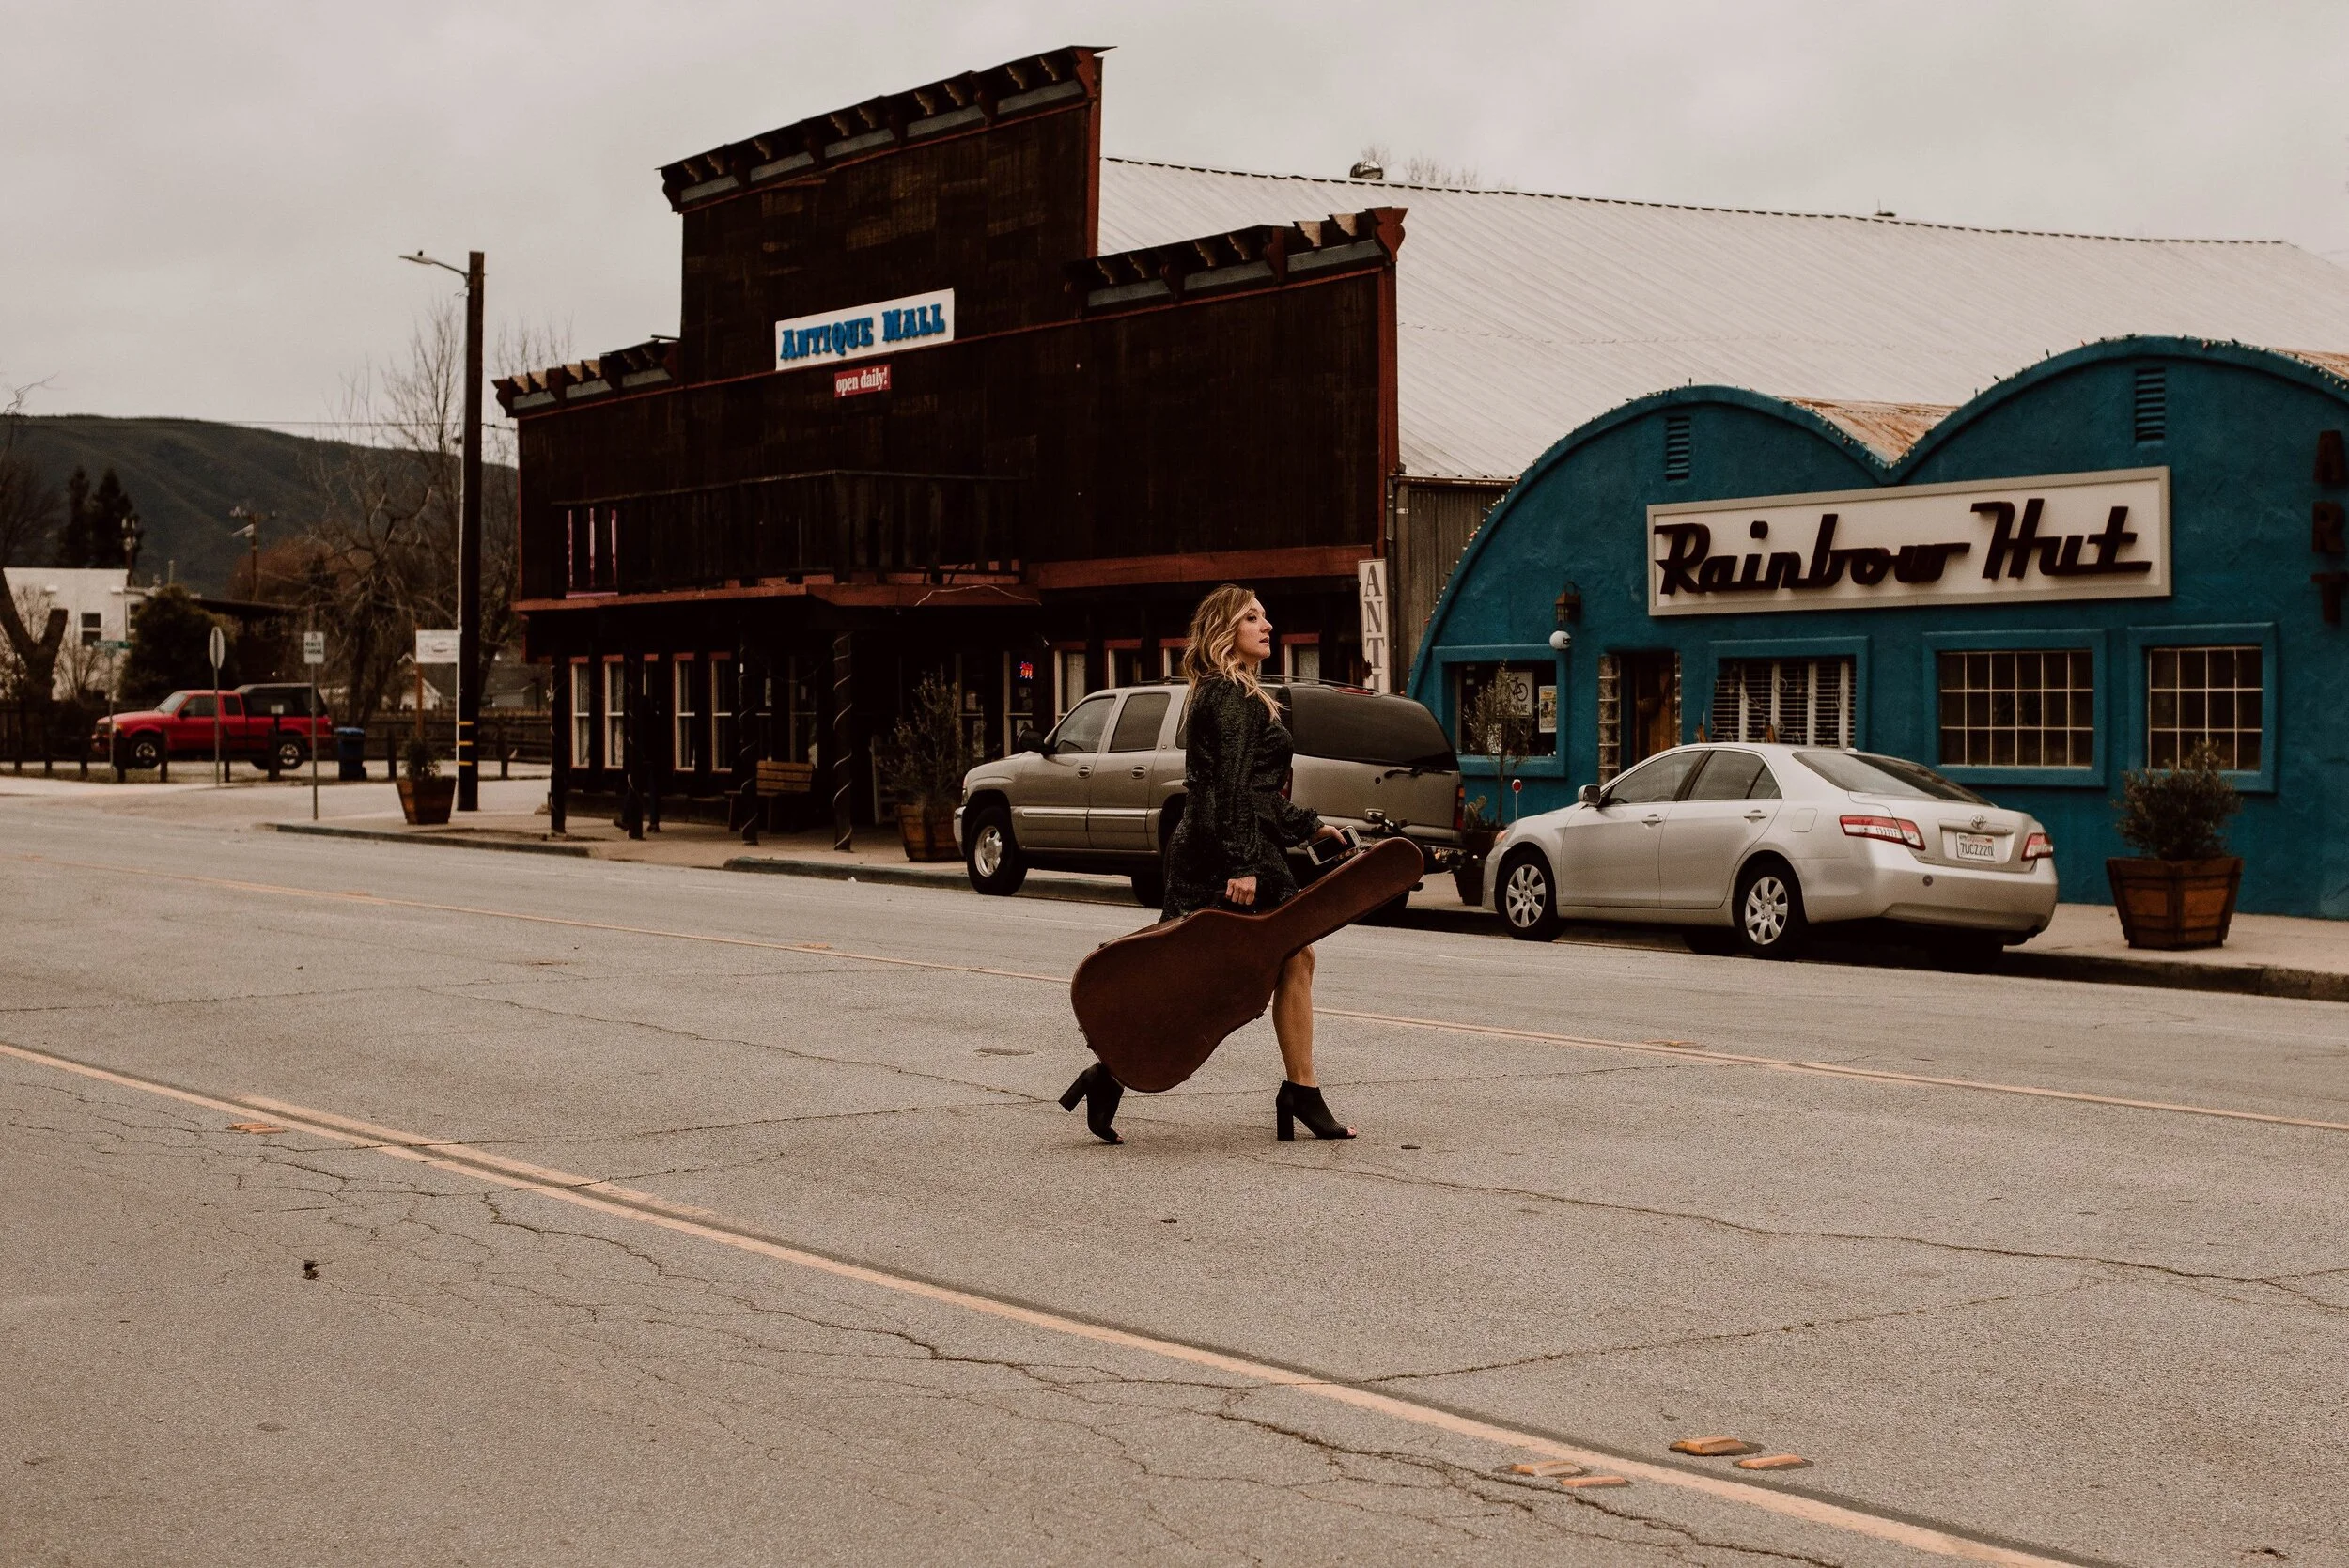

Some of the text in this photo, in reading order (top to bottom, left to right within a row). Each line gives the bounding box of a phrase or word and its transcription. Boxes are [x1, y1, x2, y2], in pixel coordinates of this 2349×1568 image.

[781, 303, 945, 359] ANTIQUE MALL
[836, 366, 888, 396] open daily!
[1654, 498, 2152, 595] Rainbow Hut
